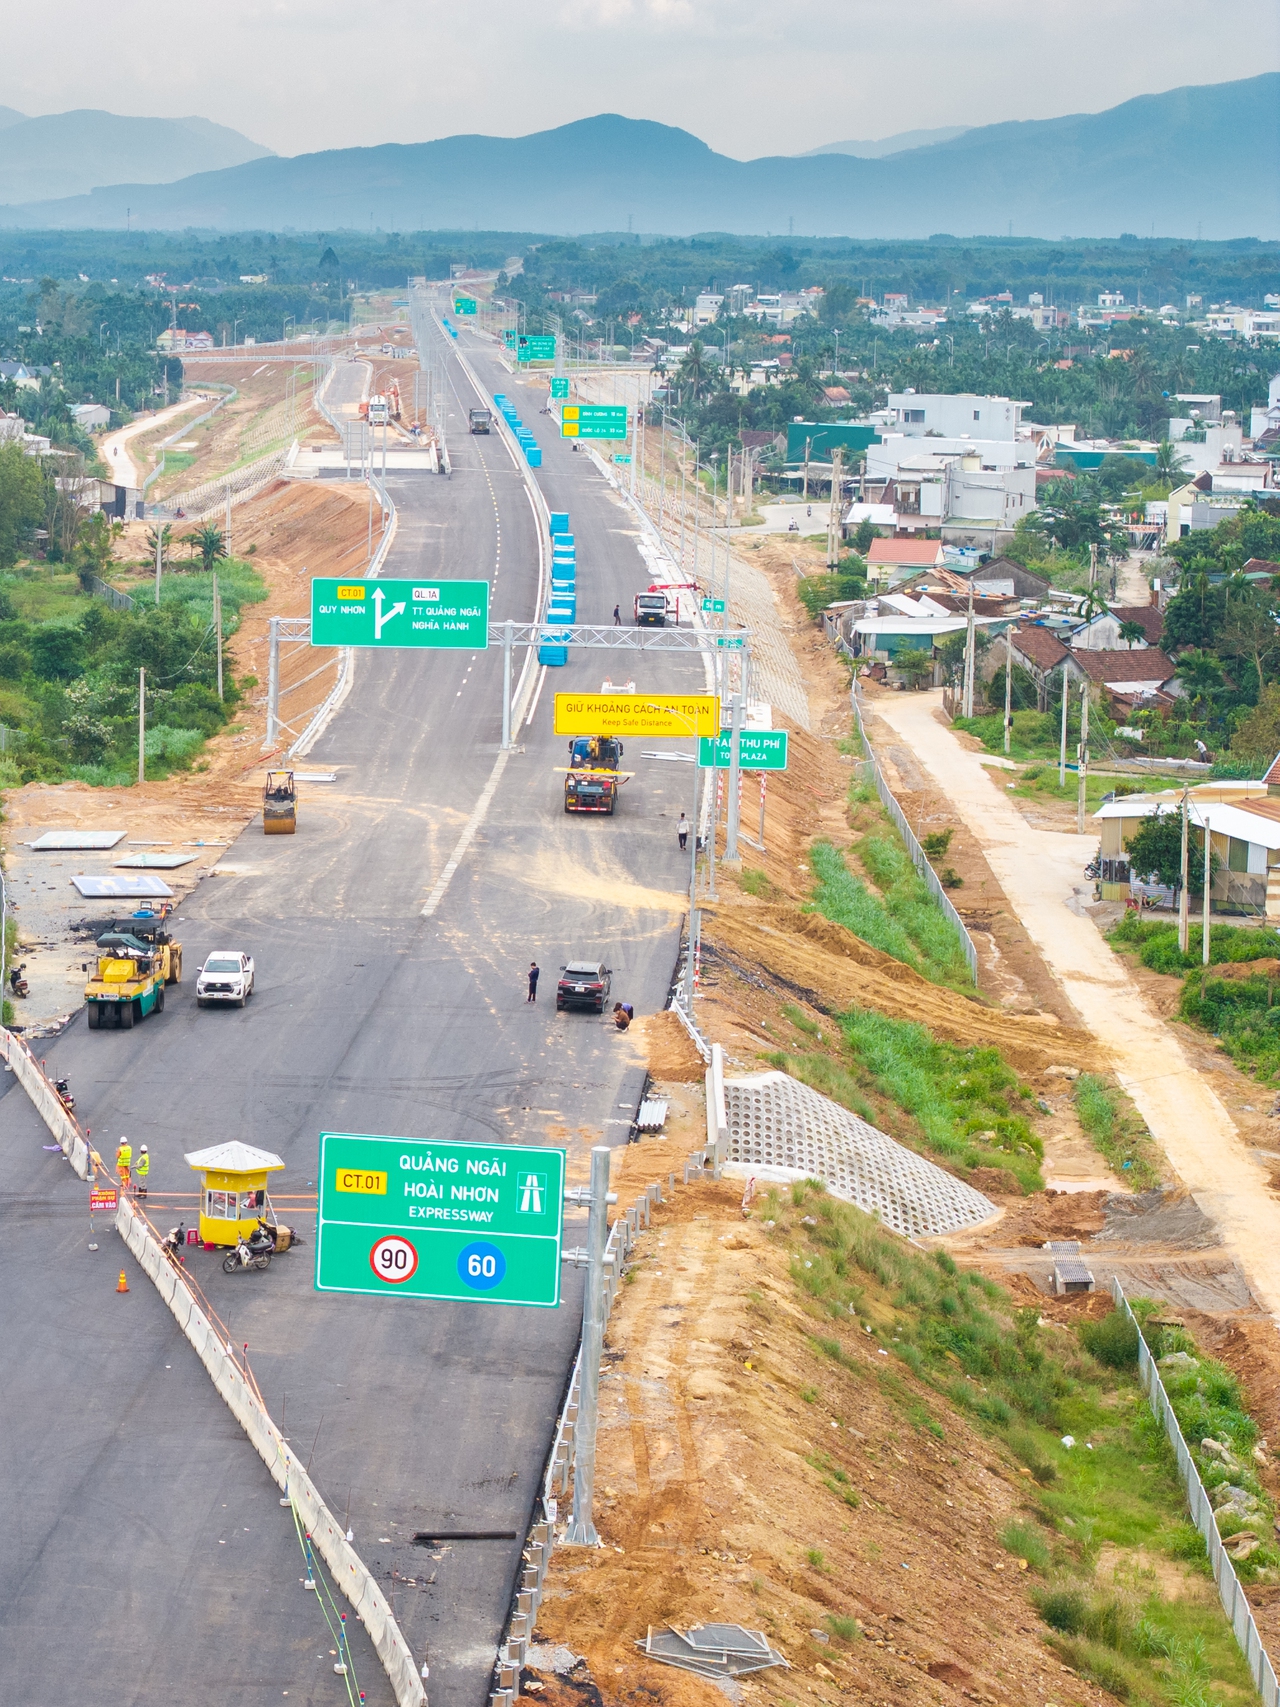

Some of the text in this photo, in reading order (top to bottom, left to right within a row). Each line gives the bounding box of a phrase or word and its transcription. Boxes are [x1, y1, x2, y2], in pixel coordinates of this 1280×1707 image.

[341, 589, 362, 598] CT.01
[414, 590, 438, 600] QL.1A
[319, 605, 366, 615] QUY NHƠN
[426, 605, 457, 617] QUẢNG
[459, 607, 481, 617] NGÃI
[412, 619, 469, 631] NGHĨA HÀNH
[566, 700, 710, 715] GIỮ KHOẢNG CÁCH AN TOÀN
[602, 718, 673, 728] Keep Safe Distance
[707, 738, 781, 750] TRẠ THU PHÍ
[741, 752, 767, 761] PLAZA
[399, 1151, 507, 1177] QUẢNG NGÃI
[343, 1173, 380, 1190] CT.01
[404, 1178, 499, 1203] HOÀI NHƠN
[409, 1205, 494, 1223] EXPRESSWAY
[381, 1248, 407, 1270] 90
[467, 1254, 496, 1278] 60
